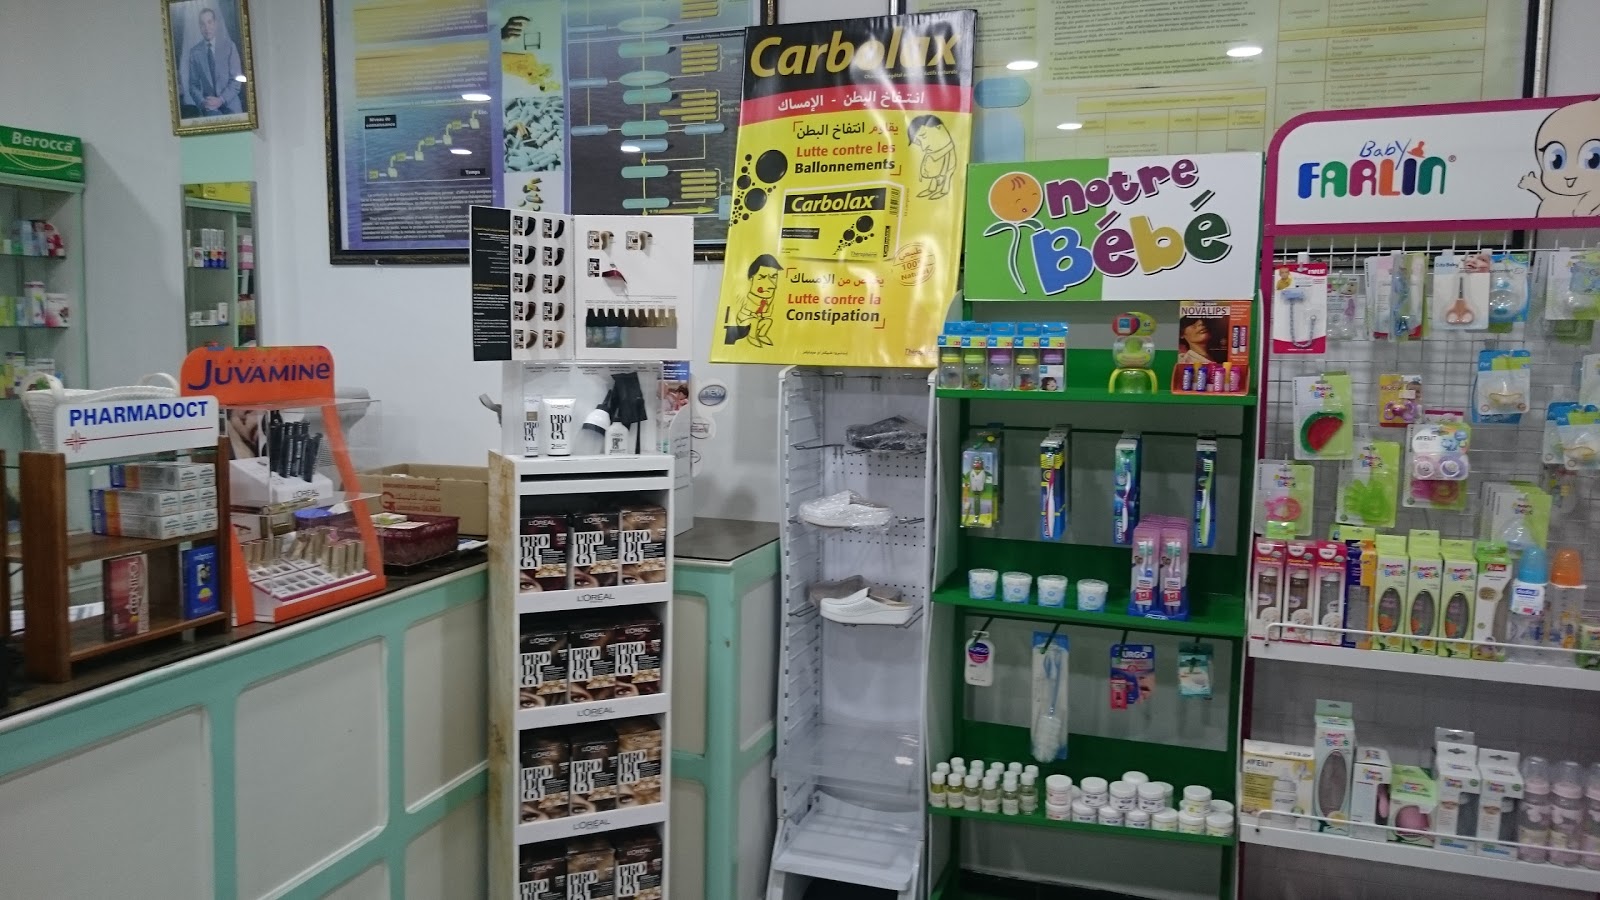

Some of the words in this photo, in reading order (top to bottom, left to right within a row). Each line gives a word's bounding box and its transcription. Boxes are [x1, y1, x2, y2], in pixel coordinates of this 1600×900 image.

[750, 26, 961, 79] Carbolax
[778, 94, 824, 112] الإمساك
[843, 90, 877, 108] البطن
[880, 91, 925, 108] انتفاخ
[797, 124, 829, 139] البطن
[832, 122, 865, 140] انتفاخ
[11, 131, 74, 152] Berocca
[796, 146, 828, 157] Lutte
[832, 144, 873, 156] contre
[877, 142, 896, 153] les
[1359, 139, 1412, 170] Baby
[794, 158, 896, 174] Ballonnements
[1045, 158, 1200, 219] notre
[791, 193, 876, 214] Carbolax
[1031, 189, 1232, 295] Bébé
[837, 277, 851, 287] من
[787, 293, 820, 304] Lutte
[823, 294, 866, 305] contre
[869, 293, 881, 305] la
[786, 308, 880, 326] Constipation
[1181, 306, 1228, 315] NOVALIPS
[69, 400, 208, 427] PHARMADOCT
[549, 414, 573, 424] PRO
[520, 535, 550, 547] PRO
[575, 532, 603, 545] PRO
[623, 530, 650, 543] PRO
[572, 647, 600, 660] PRO
[617, 642, 645, 655] PRO
[1121, 651, 1149, 659] URGO
[522, 653, 551, 665] PRO
[573, 760, 602, 773] PRO
[523, 767, 552, 780] PRO
[621, 863, 647, 876] PRO
[571, 872, 598, 885] PRO
[520, 880, 548, 893] PRO
